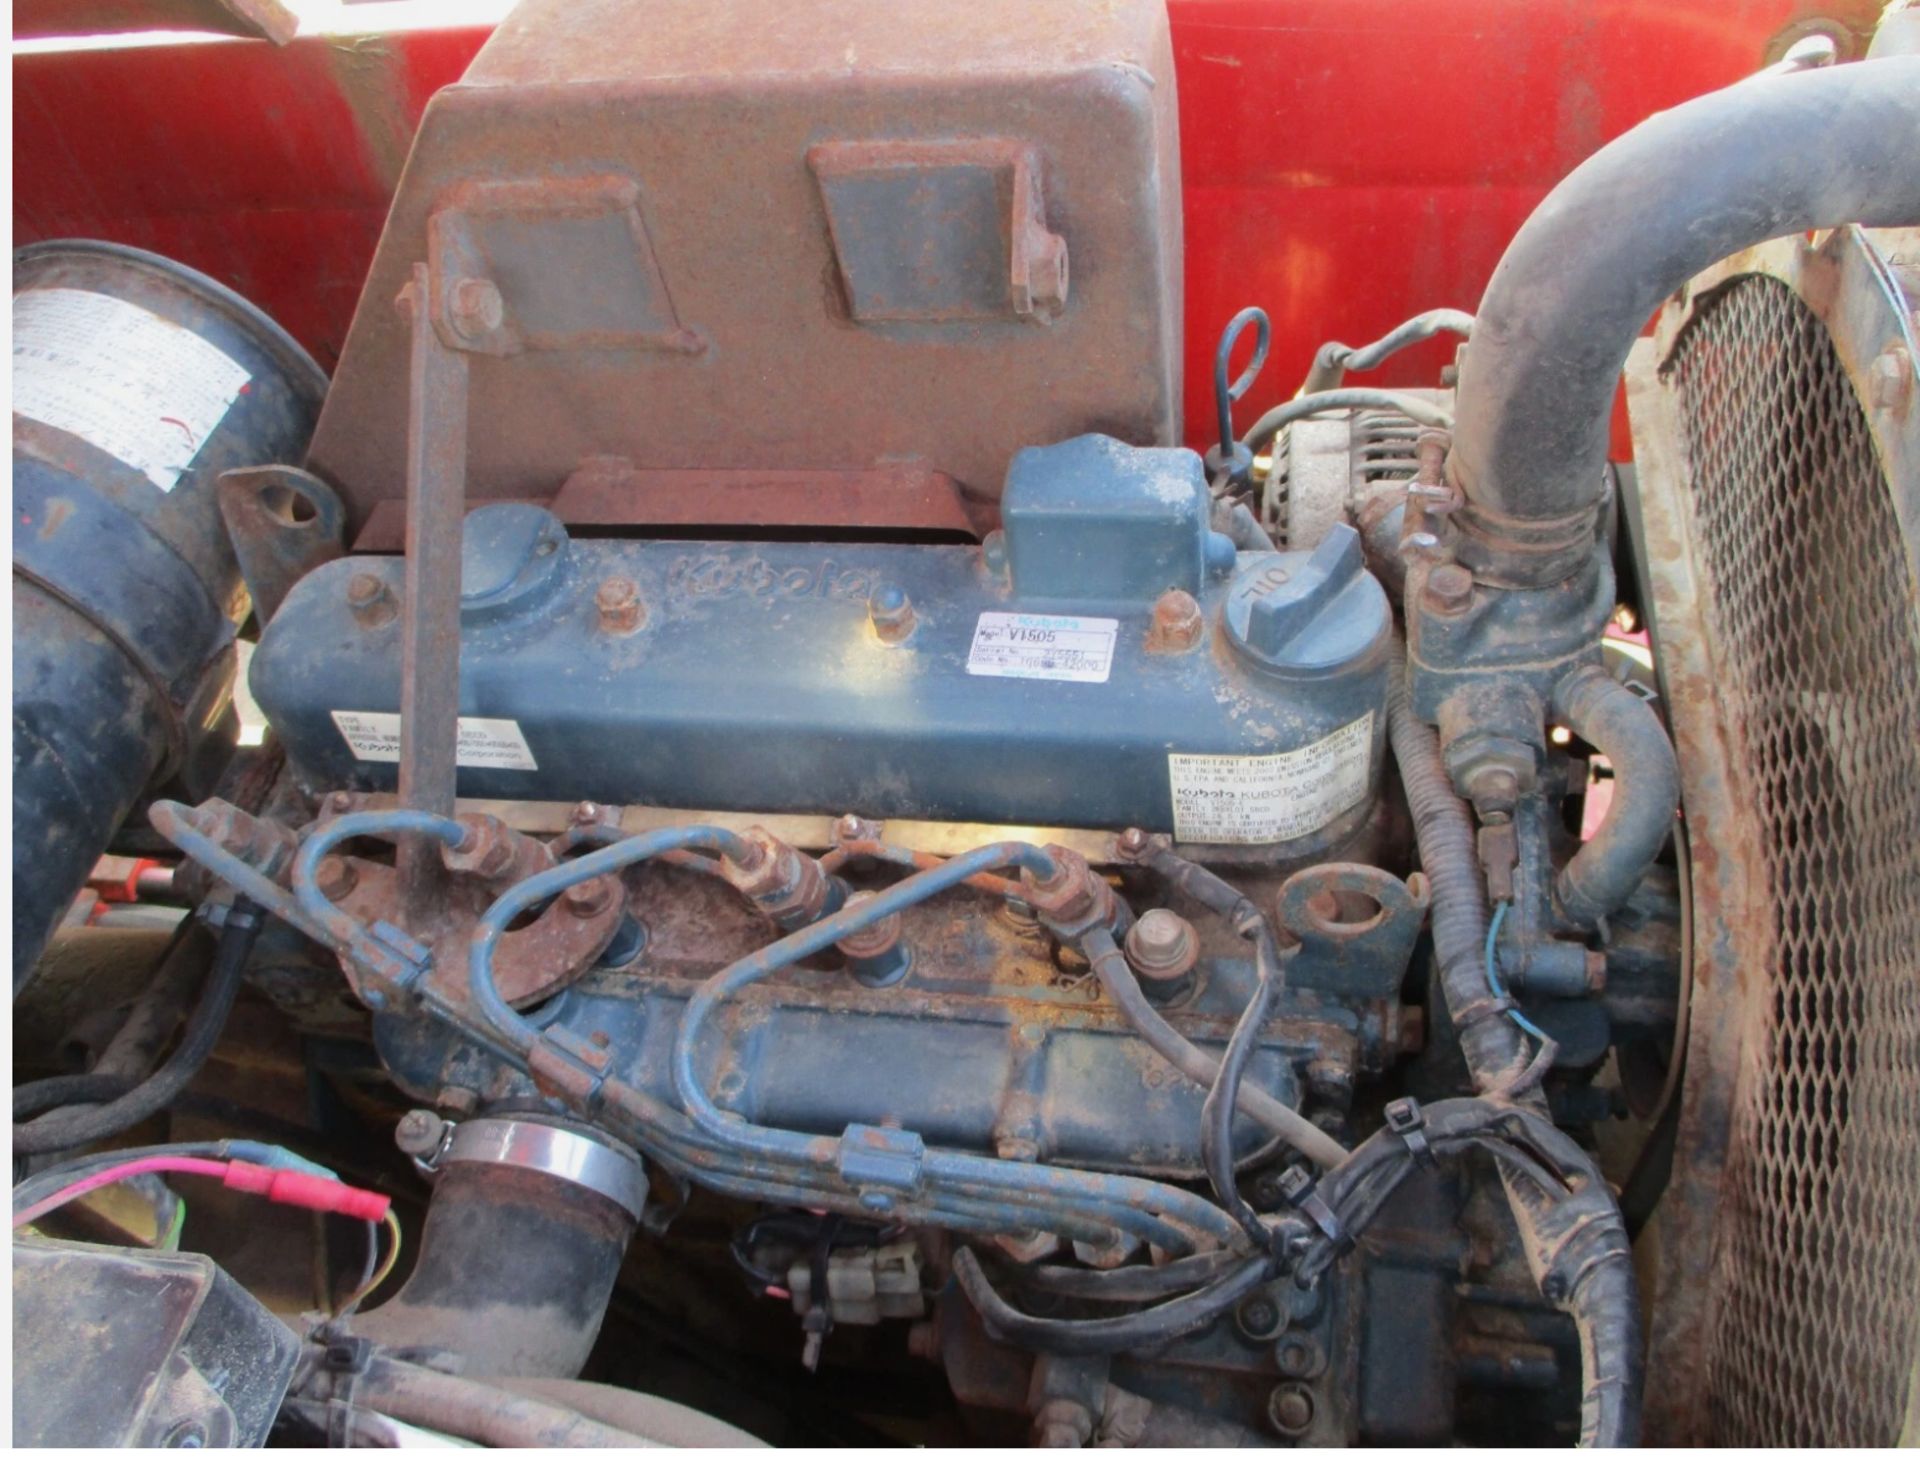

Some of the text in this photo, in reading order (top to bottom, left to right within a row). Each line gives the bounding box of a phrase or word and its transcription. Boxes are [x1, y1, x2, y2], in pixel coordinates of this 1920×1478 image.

[670, 556, 874, 600] Kubota
[1239, 567, 1290, 600] OIL
[1009, 627, 1057, 643] V1505
[1177, 787, 1236, 799] Kubota
[1240, 786, 1298, 801] KUBOTA
